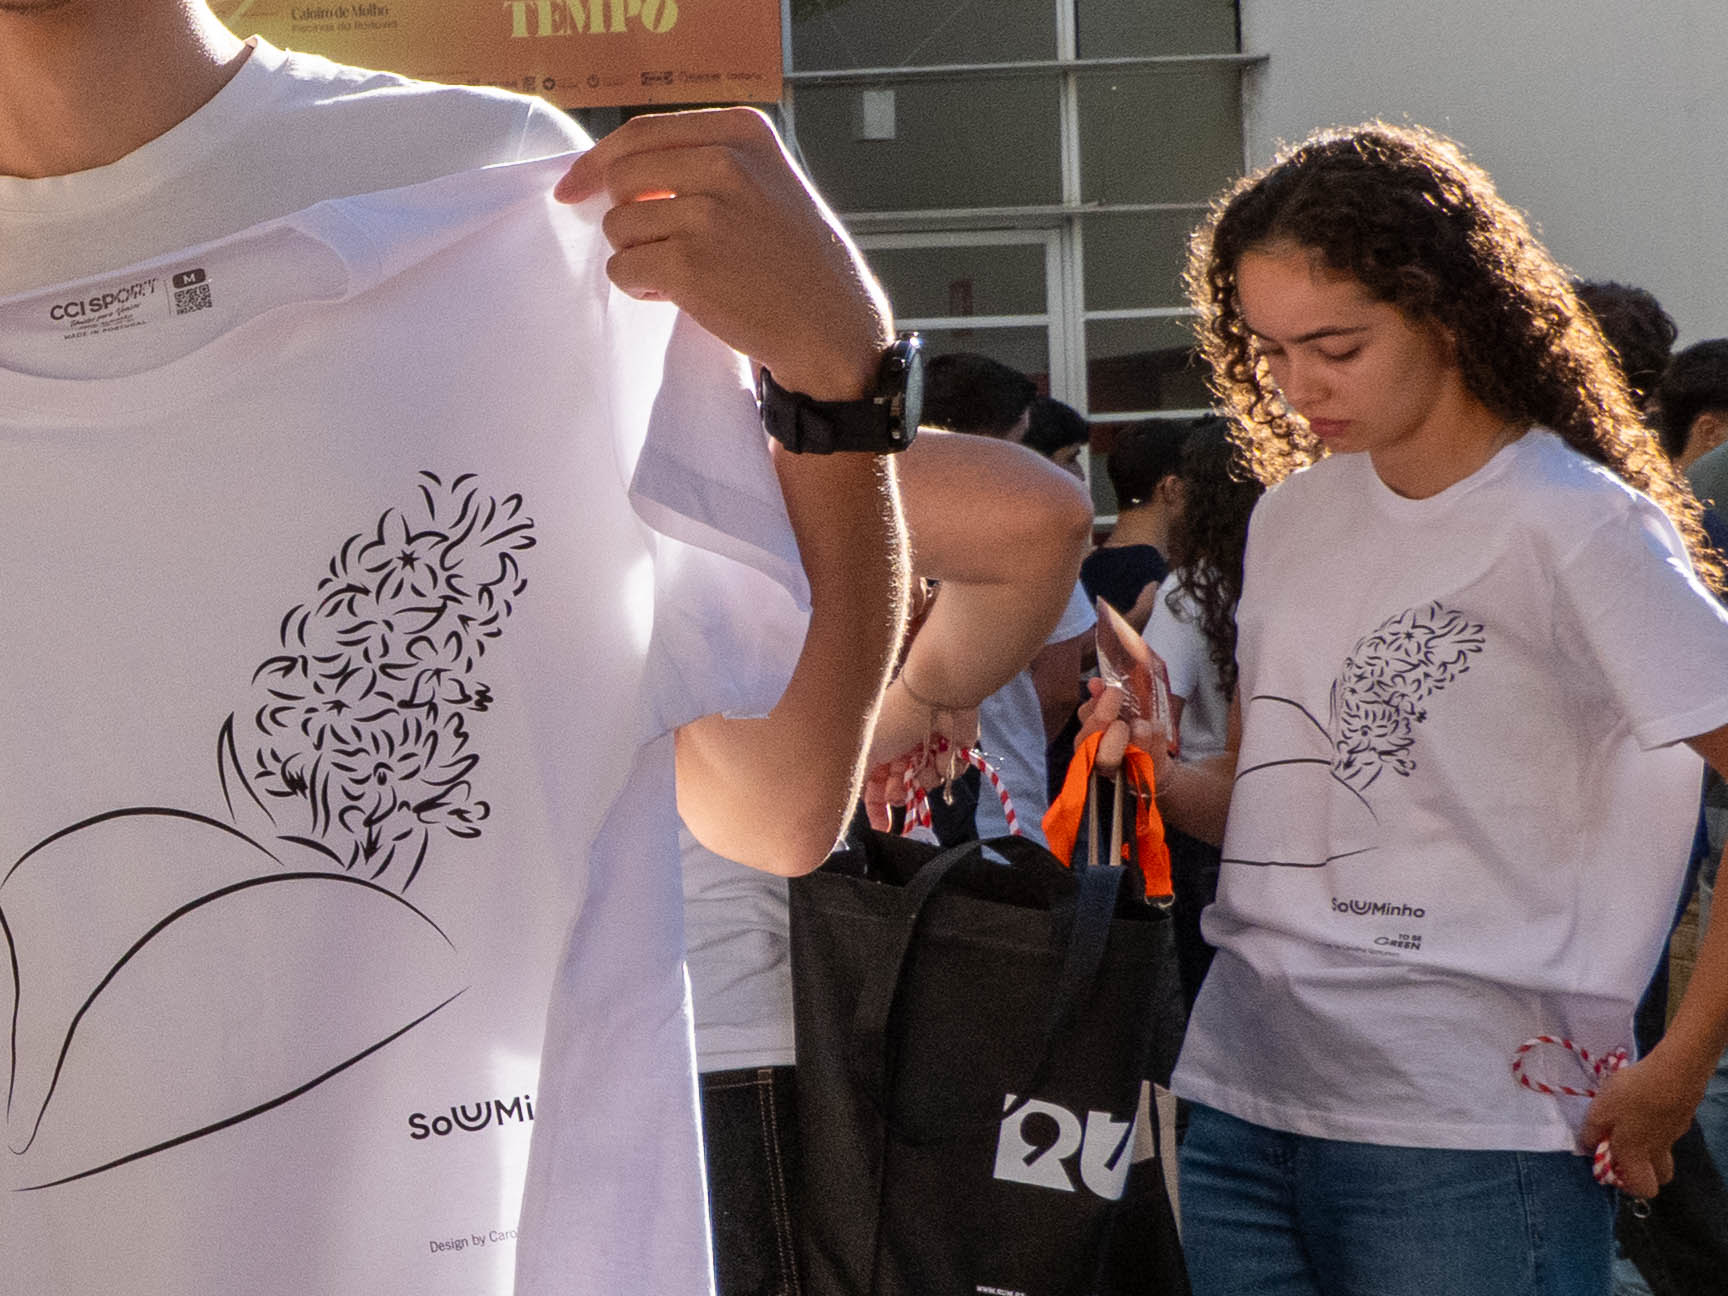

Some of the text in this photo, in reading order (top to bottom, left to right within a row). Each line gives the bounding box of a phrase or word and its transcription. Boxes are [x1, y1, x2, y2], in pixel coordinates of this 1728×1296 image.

[183, 273, 196, 284] M
[49, 301, 85, 320] CCI
[1373, 936, 1421, 951] GREEN
[1398, 933, 1409, 941] TO
[429, 1234, 469, 1253] Design
[472, 1231, 487, 1247] by
